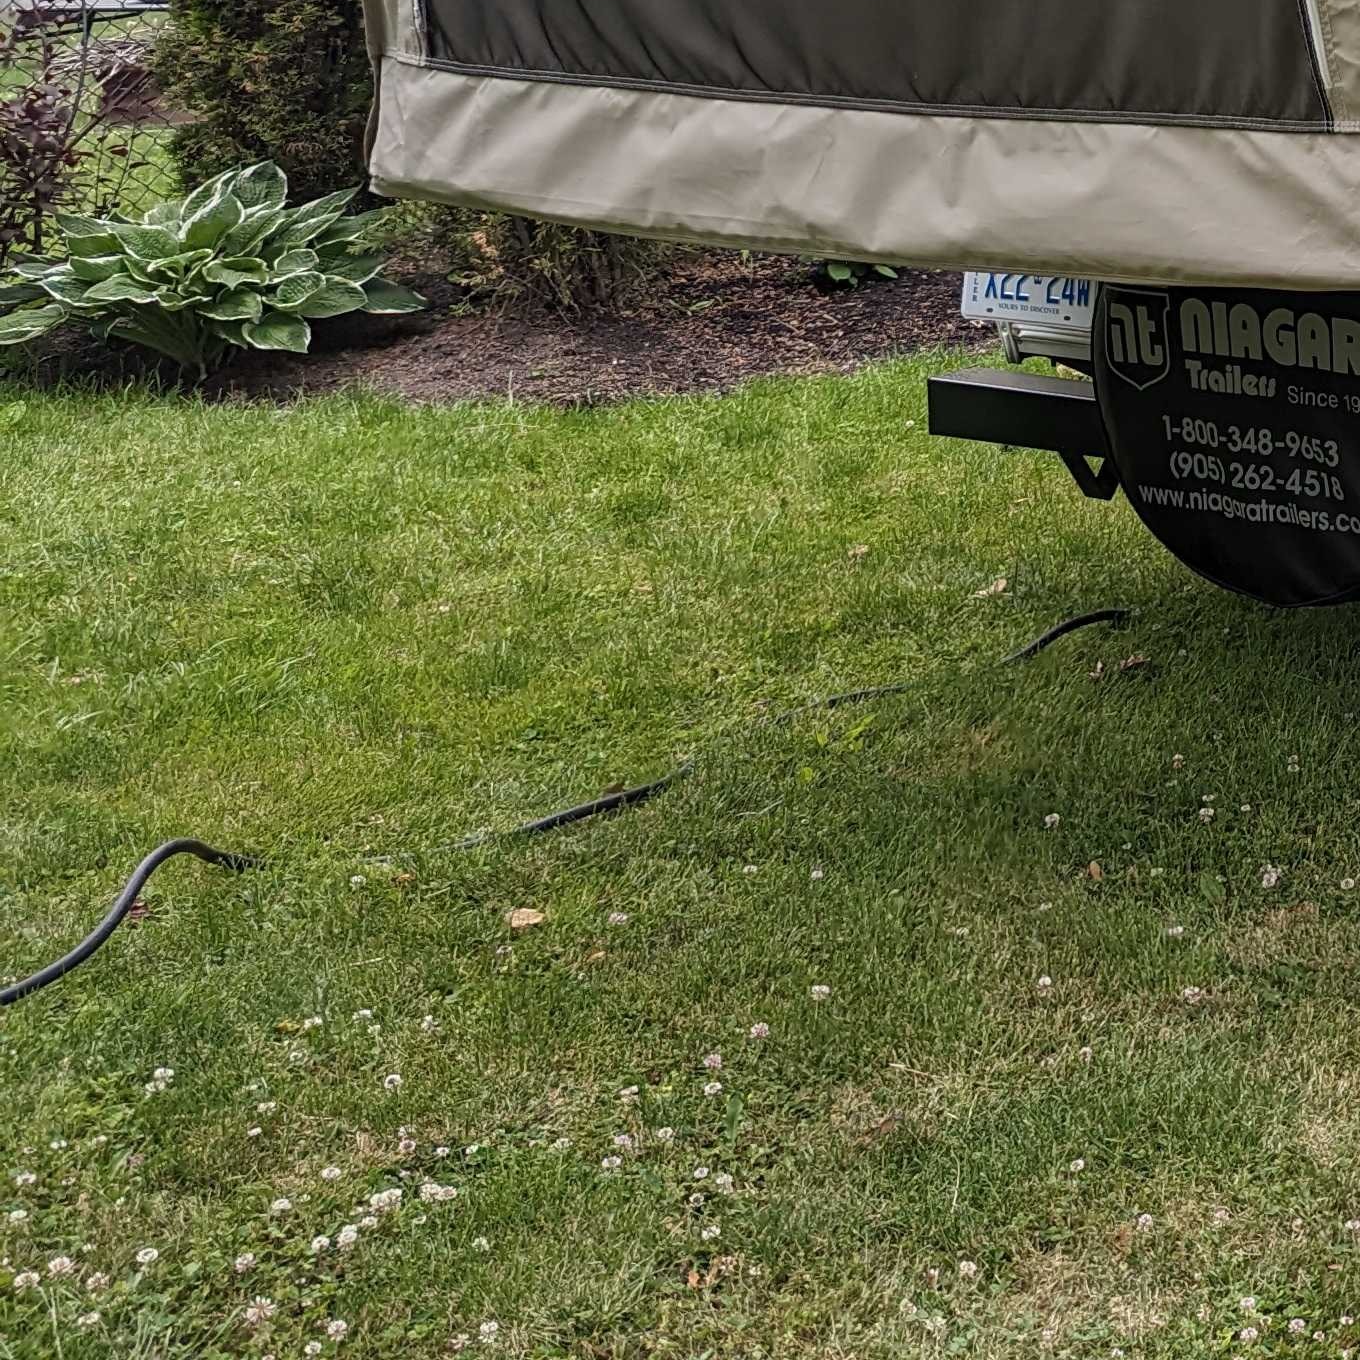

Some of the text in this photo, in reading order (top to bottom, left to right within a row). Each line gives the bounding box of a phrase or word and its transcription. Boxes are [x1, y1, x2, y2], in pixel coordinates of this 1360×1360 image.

[999, 303, 1018, 311] YOURS
[1030, 305, 1060, 314] DISCOVER
[1185, 359, 1276, 398] Trailers
[1287, 385, 1339, 408] Since
[1162, 414, 1339, 468] 1-800-348-9653
[1170, 450, 1345, 501] (905) 262-4518
